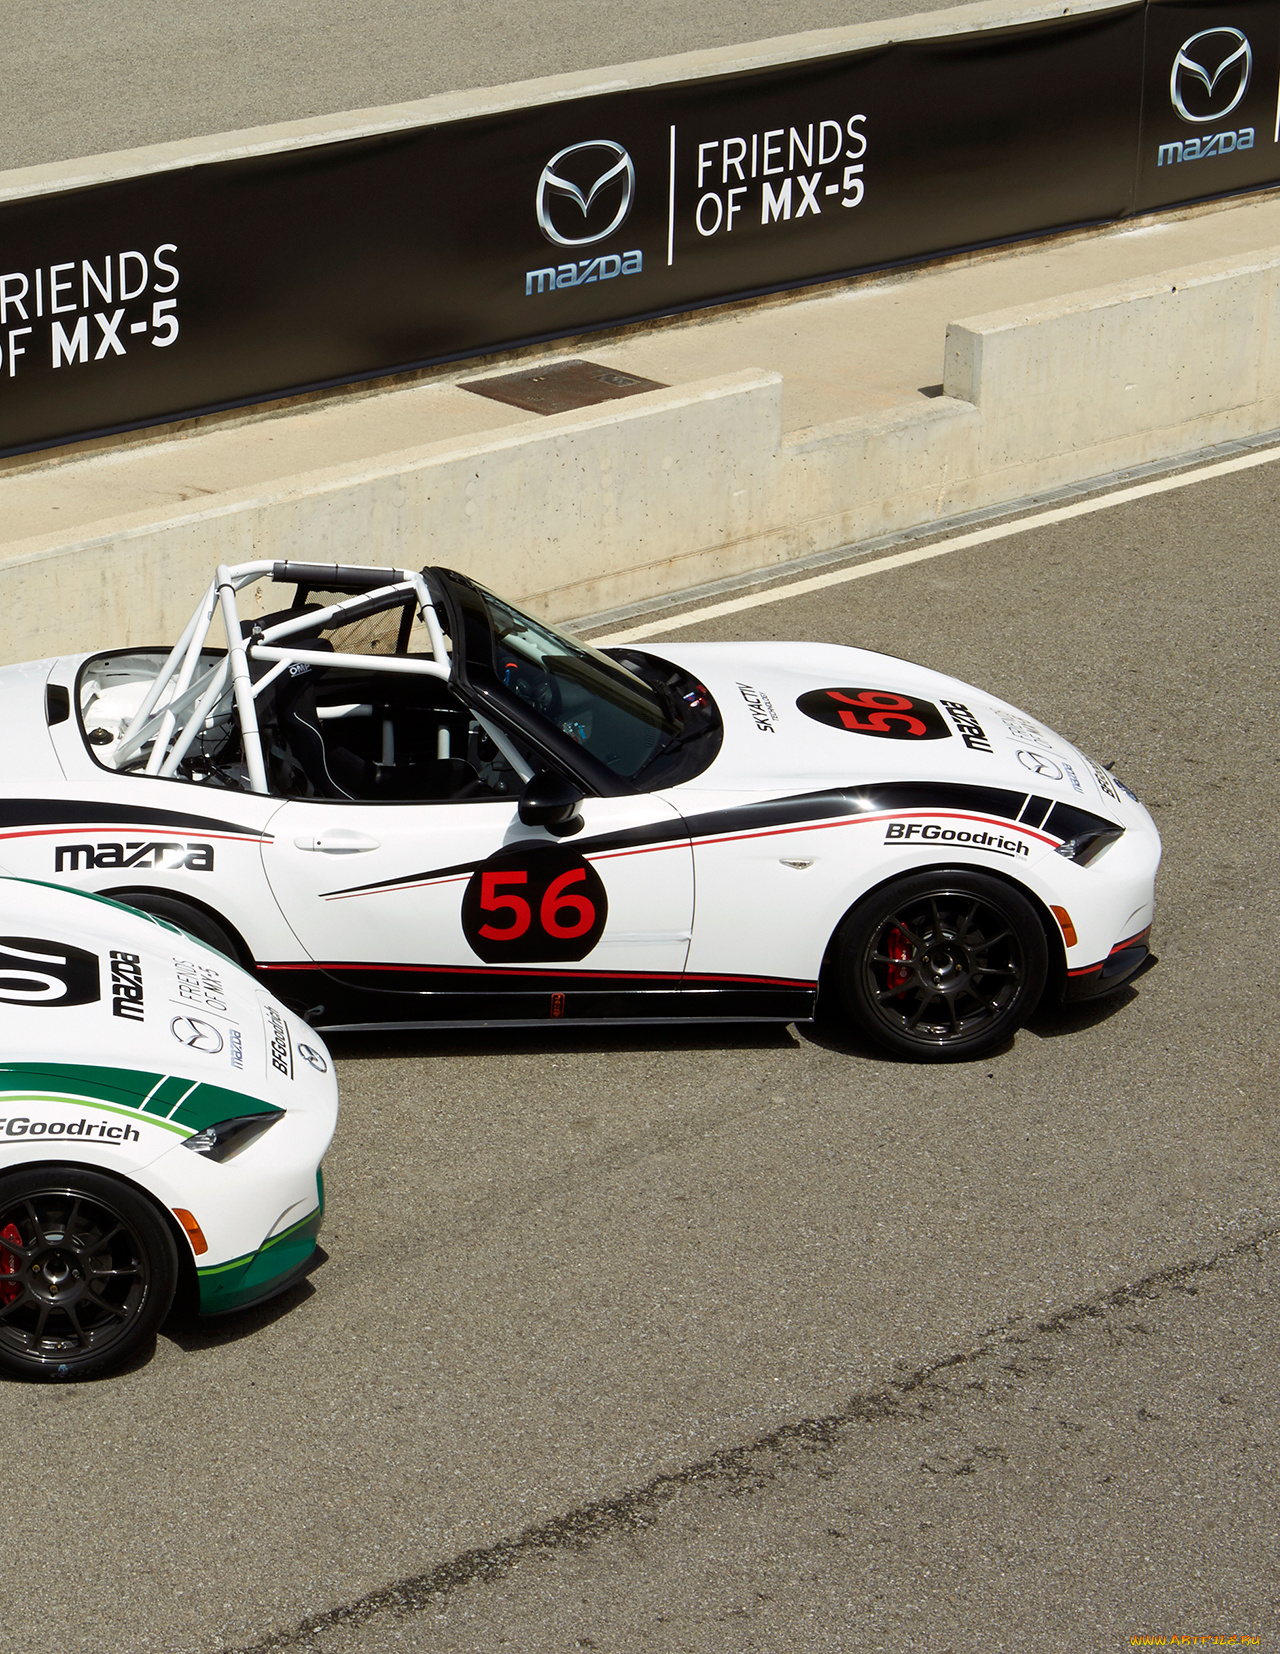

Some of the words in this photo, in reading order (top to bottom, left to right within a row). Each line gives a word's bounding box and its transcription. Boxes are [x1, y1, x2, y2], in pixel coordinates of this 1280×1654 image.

[697, 113, 868, 188] FRIENDS
[695, 186, 748, 237] OF
[761, 164, 865, 224] MX-5
[51, 298, 180, 369] MX-5
[735, 681, 775, 733] SKYACTIV
[826, 691, 927, 736] 56
[885, 823, 1030, 857] BFGoodrich
[477, 867, 596, 941] 56
[172, 957, 202, 1004] FRIENDS
[204, 991, 227, 1011] OF
